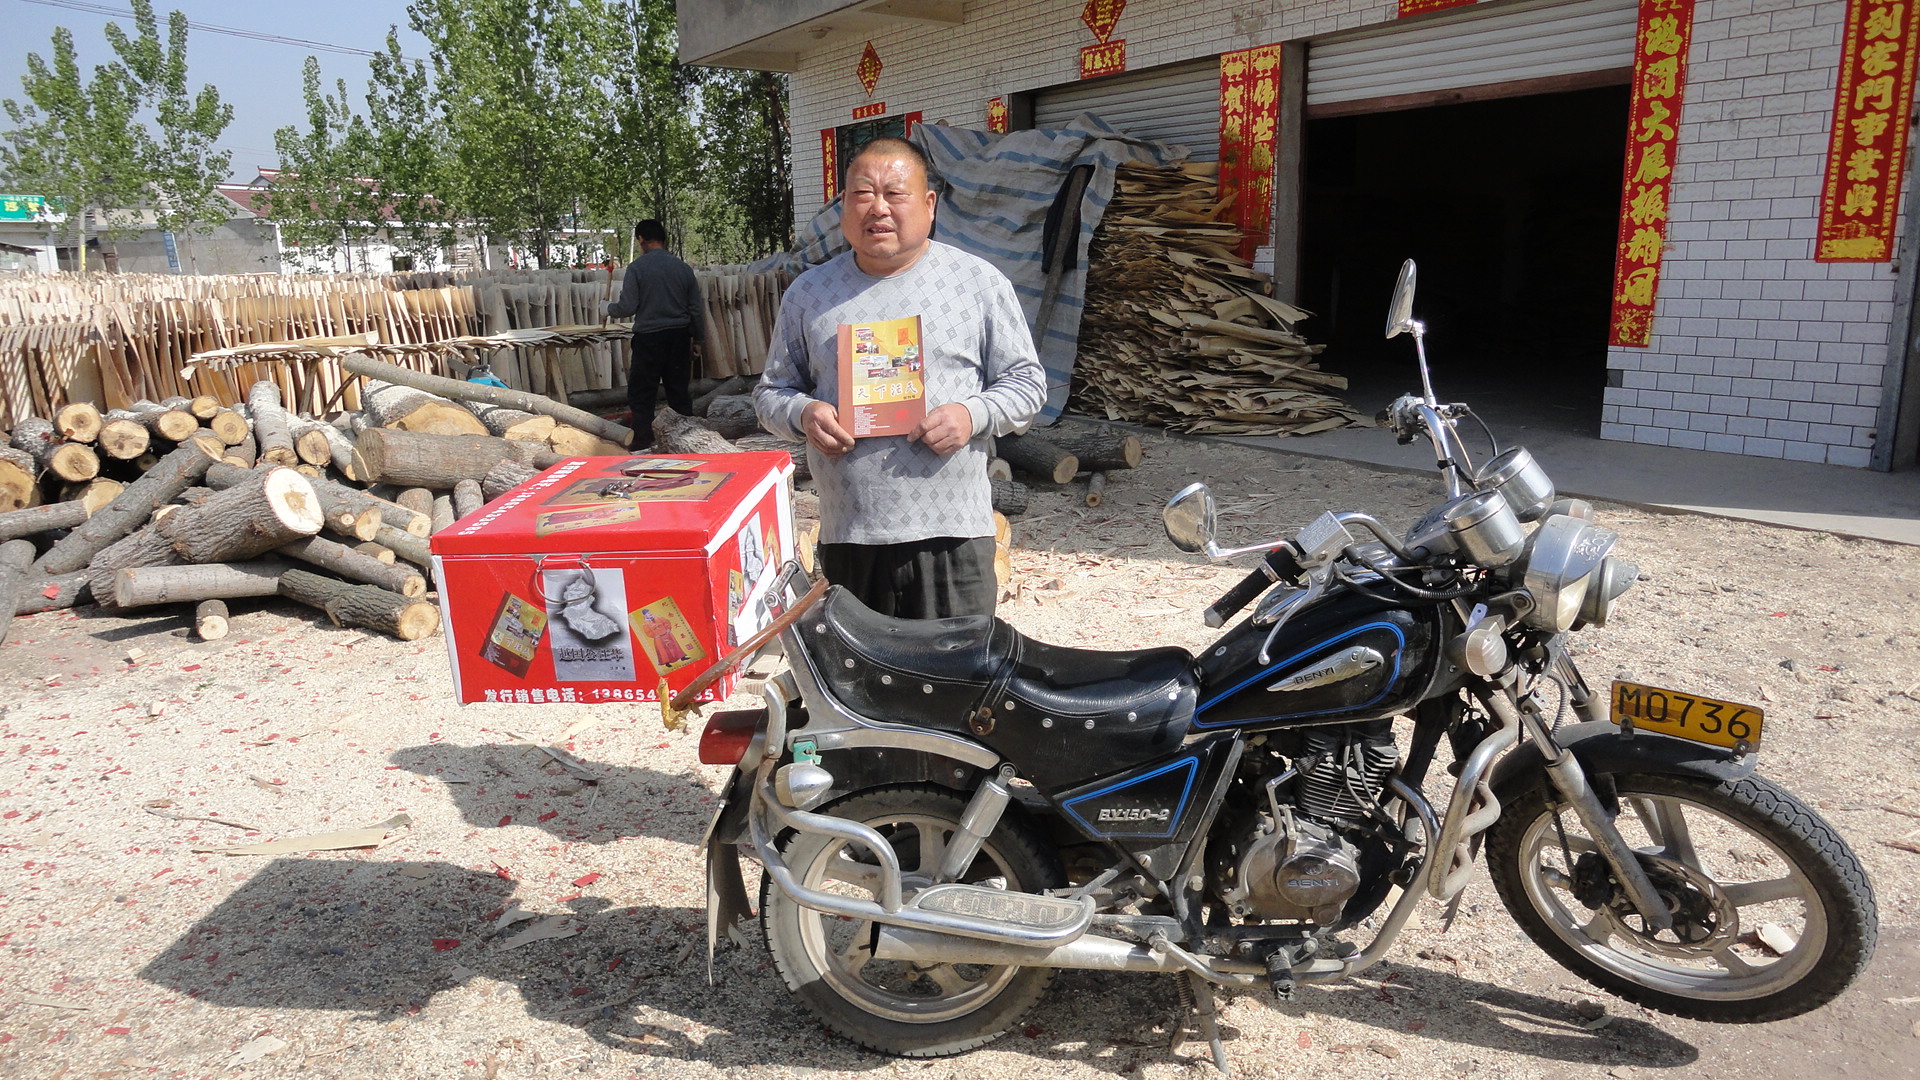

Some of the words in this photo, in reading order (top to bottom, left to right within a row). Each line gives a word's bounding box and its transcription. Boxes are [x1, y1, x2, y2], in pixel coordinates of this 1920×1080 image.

[1294, 666, 1336, 684] BENYI
[1098, 808, 1170, 821] BY150-2
[1287, 878, 1340, 887] BENYI
